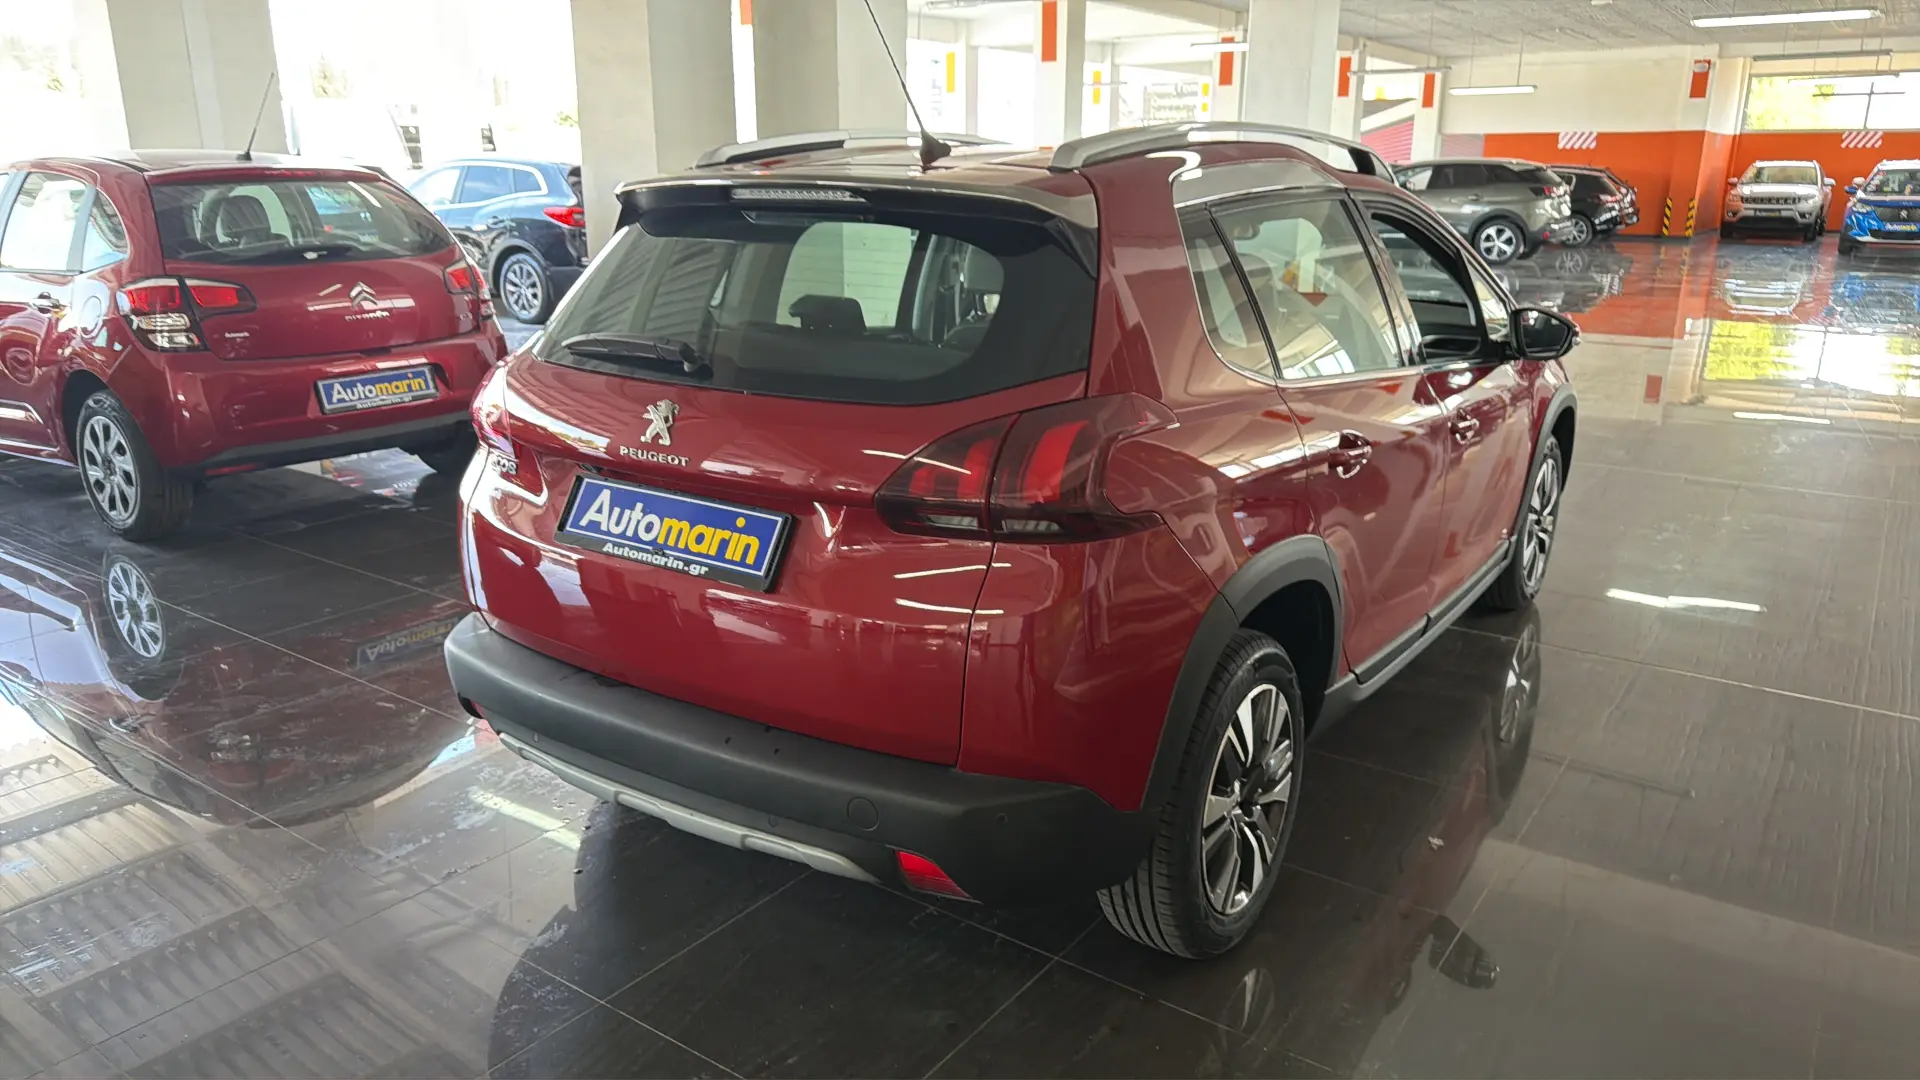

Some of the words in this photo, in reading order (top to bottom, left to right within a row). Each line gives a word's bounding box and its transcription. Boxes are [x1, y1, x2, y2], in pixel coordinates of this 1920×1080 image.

[332, 373, 426, 403] Automarin
[356, 396, 412, 409] Automarin.gr
[620, 446, 689, 467] PEUGEOT
[579, 488, 760, 566] Automarin
[602, 542, 709, 576] Automarin.gr
